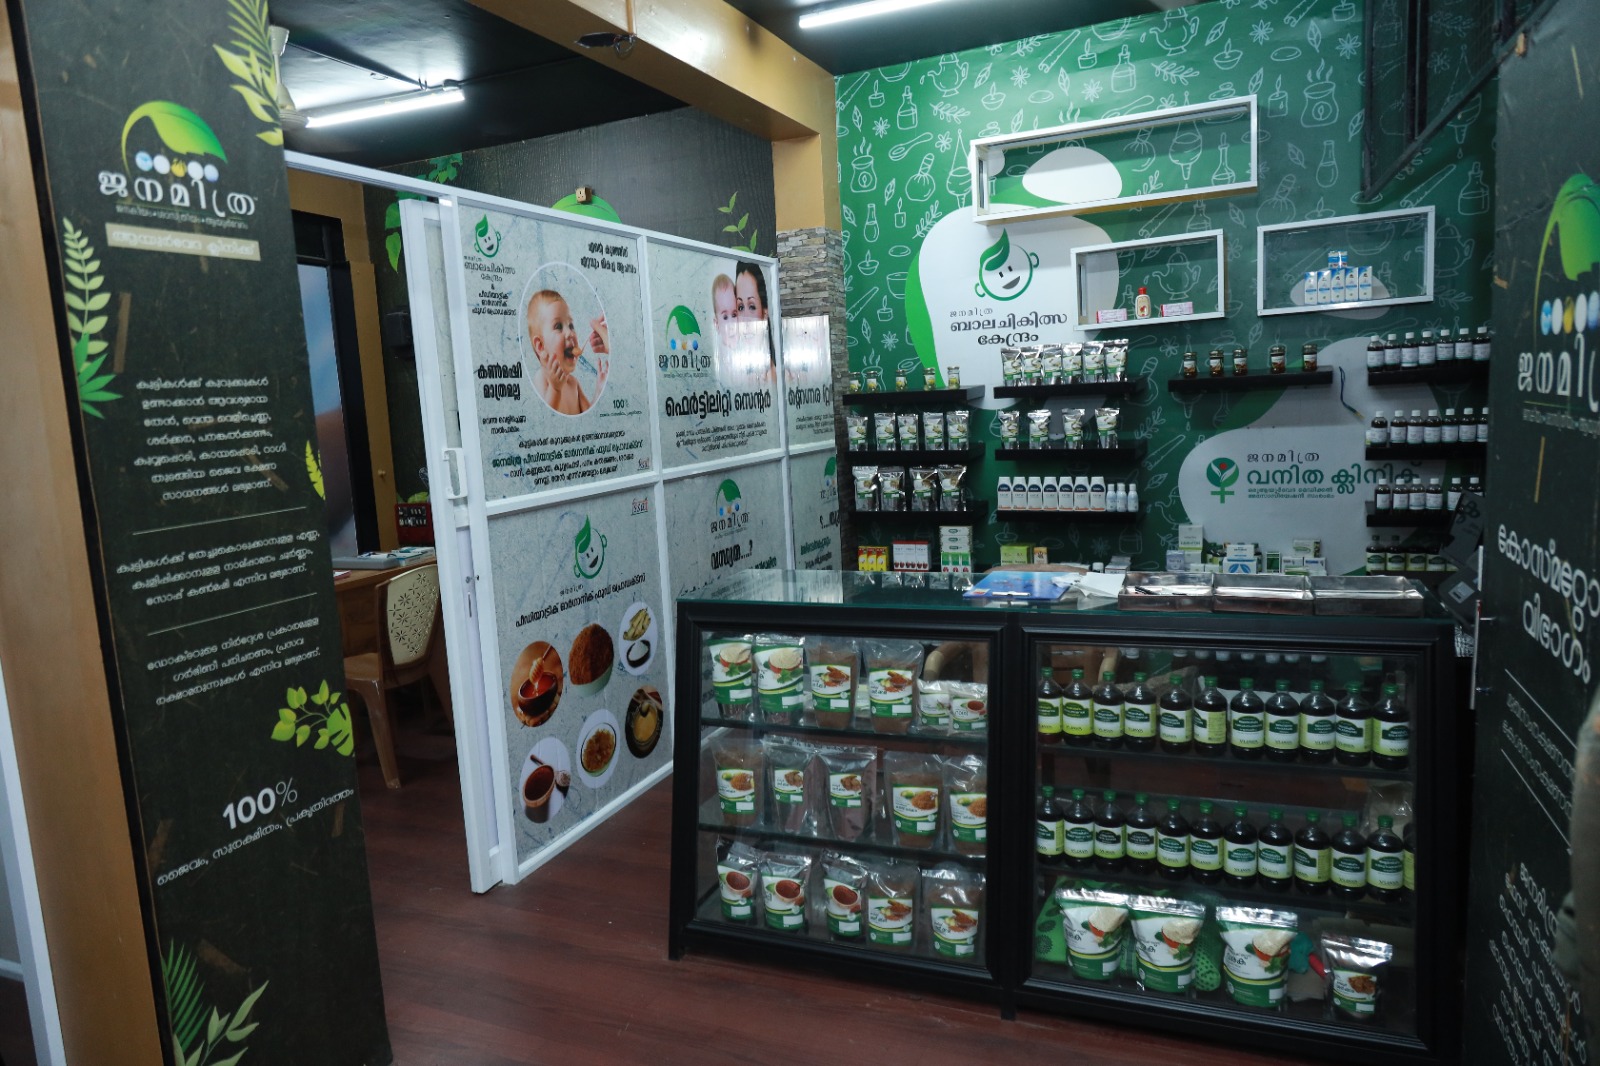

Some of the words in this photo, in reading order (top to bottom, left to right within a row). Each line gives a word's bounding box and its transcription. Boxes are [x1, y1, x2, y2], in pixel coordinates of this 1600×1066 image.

[98, 171, 256, 218] ജനമിത്ര
[977, 331, 1039, 348] കേന്ദ്രം
[657, 350, 711, 372] ജനമിത്ര
[1517, 333, 1600, 413] ജനമി
[1246, 449, 1320, 464] ജനമിത്ര
[1246, 463, 1325, 486] വനിത
[1522, 592, 1592, 685] വിഭാഗം
[222, 776, 299, 831] 100%
